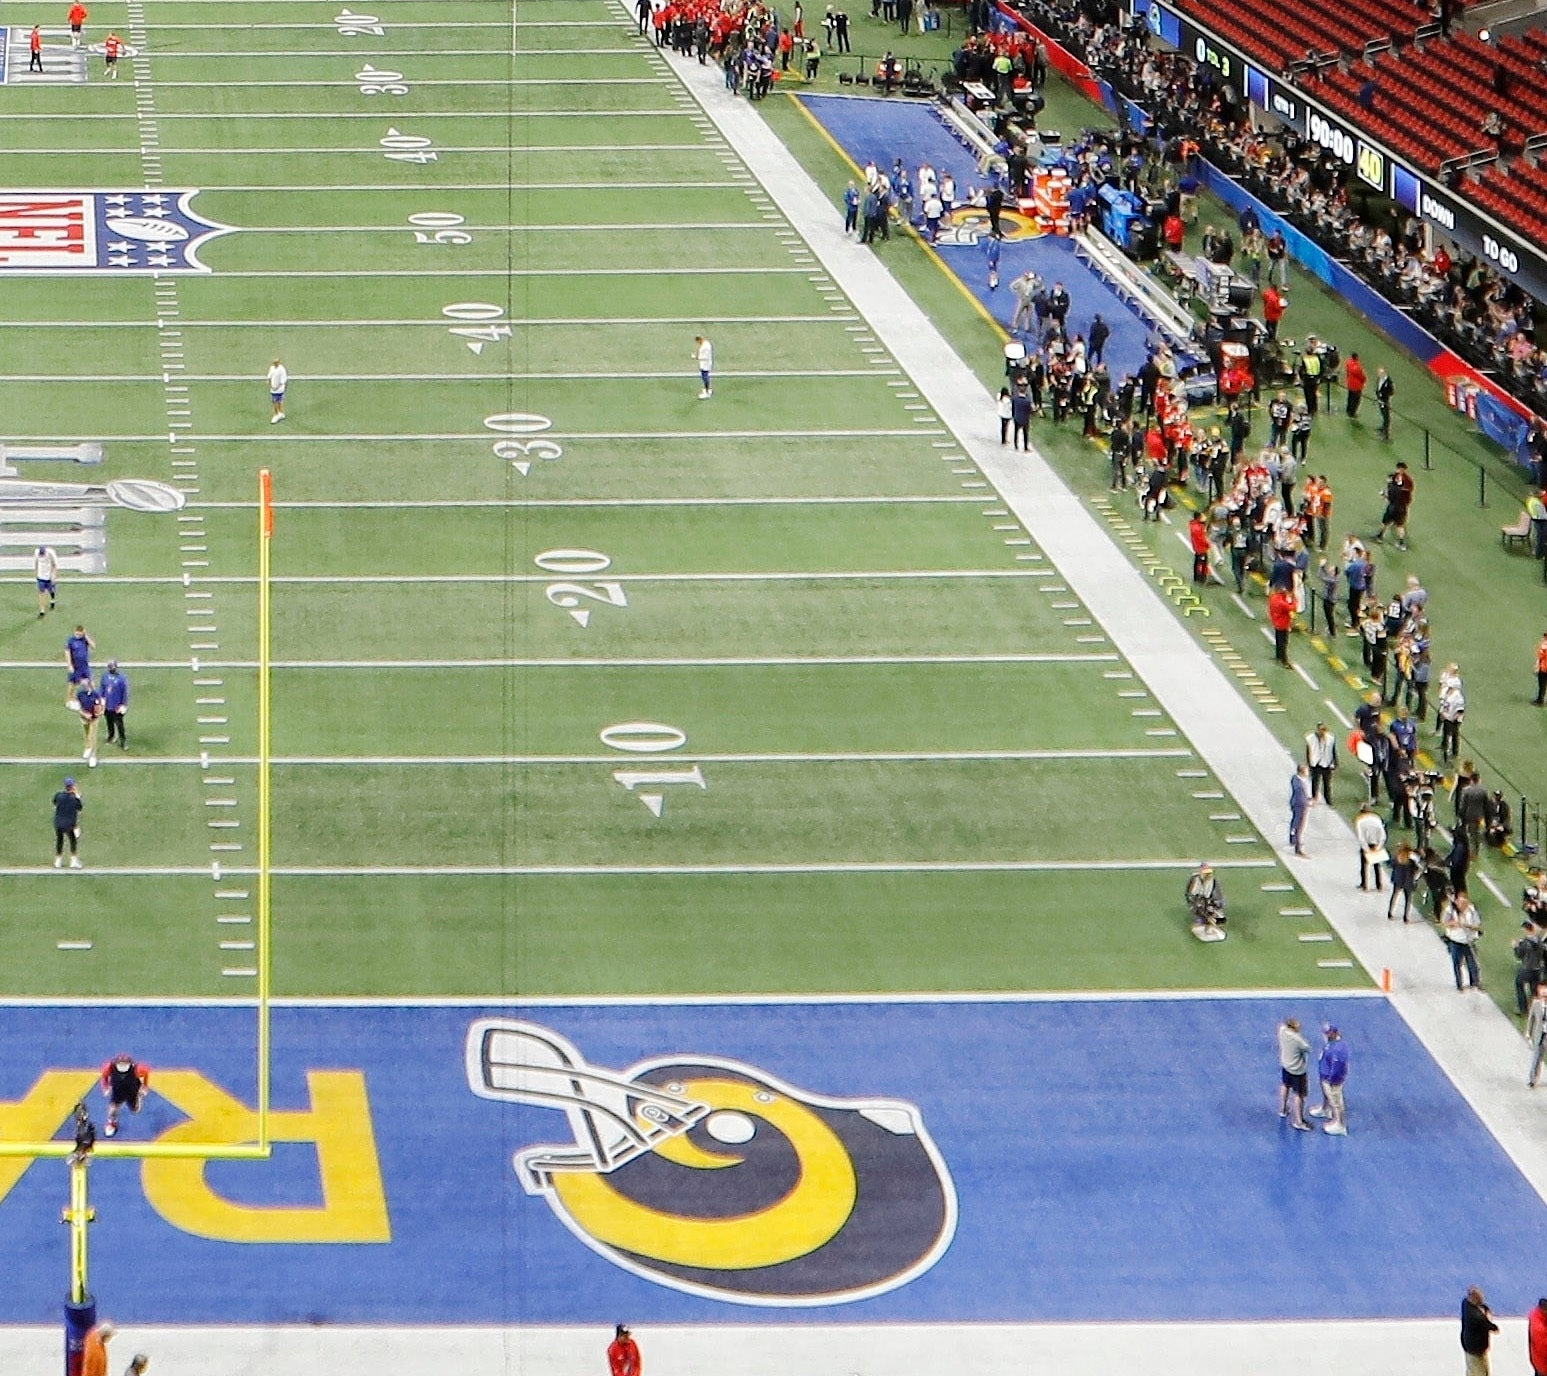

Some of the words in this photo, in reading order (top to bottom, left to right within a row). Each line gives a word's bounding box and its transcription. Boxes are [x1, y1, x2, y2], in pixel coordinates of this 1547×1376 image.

[334, 15, 385, 36] 20
[354, 70, 409, 95] 30
[1221, 56, 1230, 77] 3
[379, 135, 439, 164] 40
[1309, 113, 1354, 165] 90:00
[1359, 148, 1382, 185] 40
[407, 211, 473, 245] 50
[1422, 194, 1454, 230] DOWN
[1482, 234, 1498, 259] TO
[1498, 246, 1519, 274] GO
[441, 301, 513, 341] 40
[483, 412, 563, 460] 30
[534, 548, 628, 607] 20
[599, 720, 707, 790] 10
